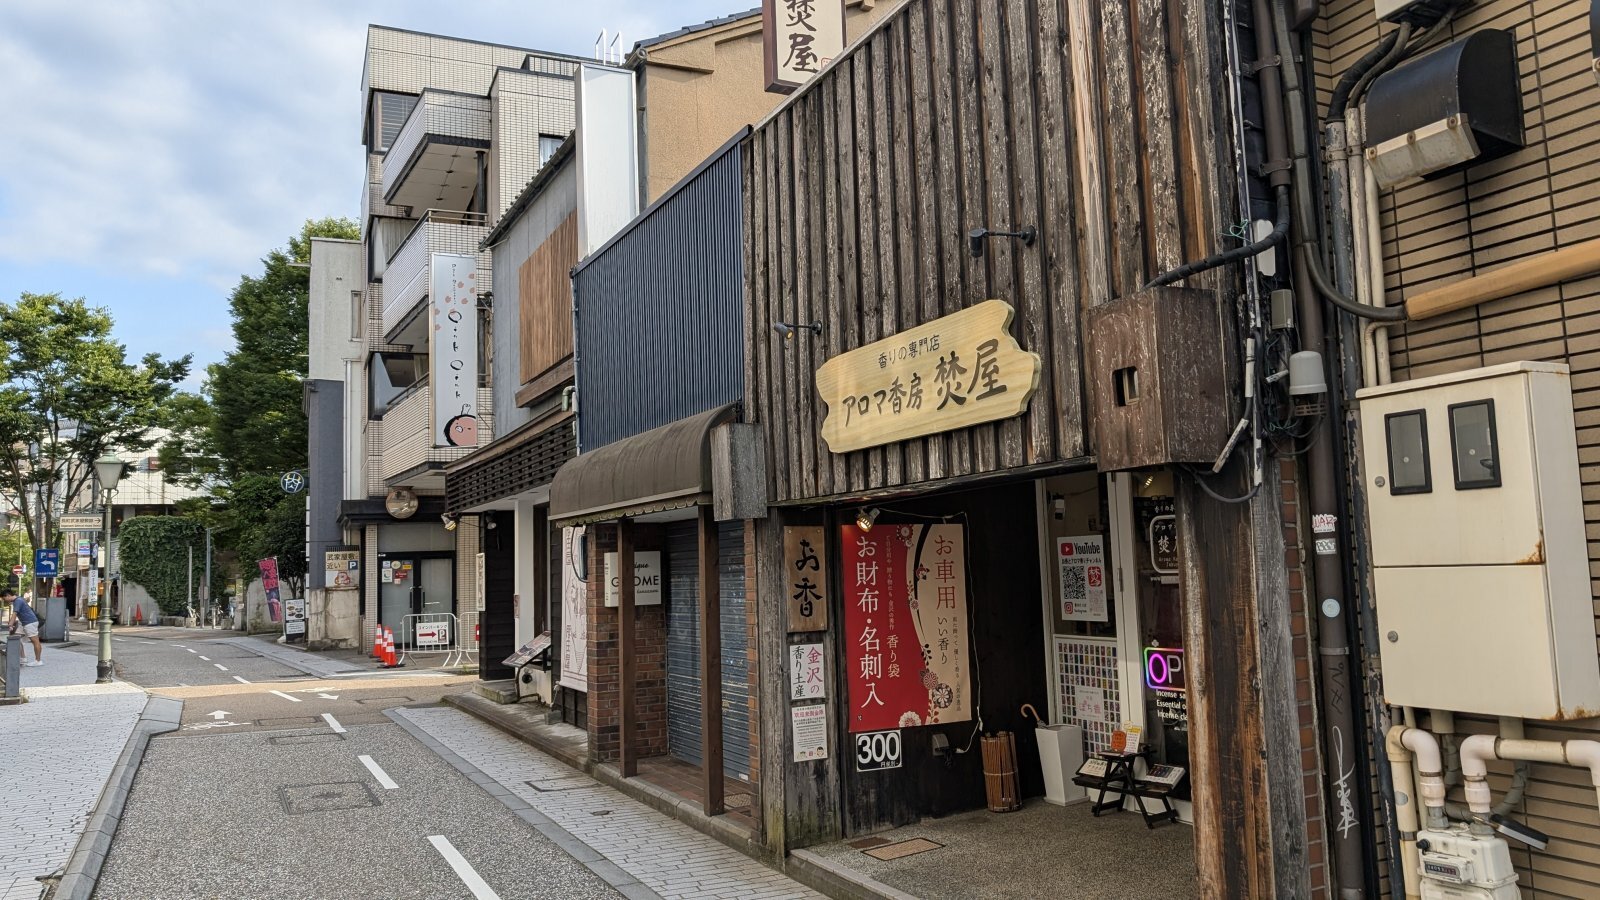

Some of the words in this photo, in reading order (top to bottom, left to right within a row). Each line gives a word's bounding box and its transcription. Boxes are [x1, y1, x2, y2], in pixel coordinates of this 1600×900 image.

[783, 0, 820, 73] 焚屋
[878, 334, 940, 369] 香りの専門店
[842, 373, 923, 428] アロマ香房
[934, 338, 1007, 411] 焚屋
[350, 561, 357, 569] P
[1074, 542, 1100, 554] YouTube
[611, 575, 660, 587] GOME
[793, 539, 823, 617] お香
[934, 534, 956, 610] お車用
[856, 535, 885, 709] お財布・名刺入
[937, 616, 949, 665] いい香り
[792, 646, 806, 698] 香り土産
[807, 646, 823, 695] 金沢の
[886, 634, 900, 678] 香り袋
[1148, 653, 1186, 684] OP
[1157, 700, 1181, 710] Essential
[858, 732, 900, 764] 300
